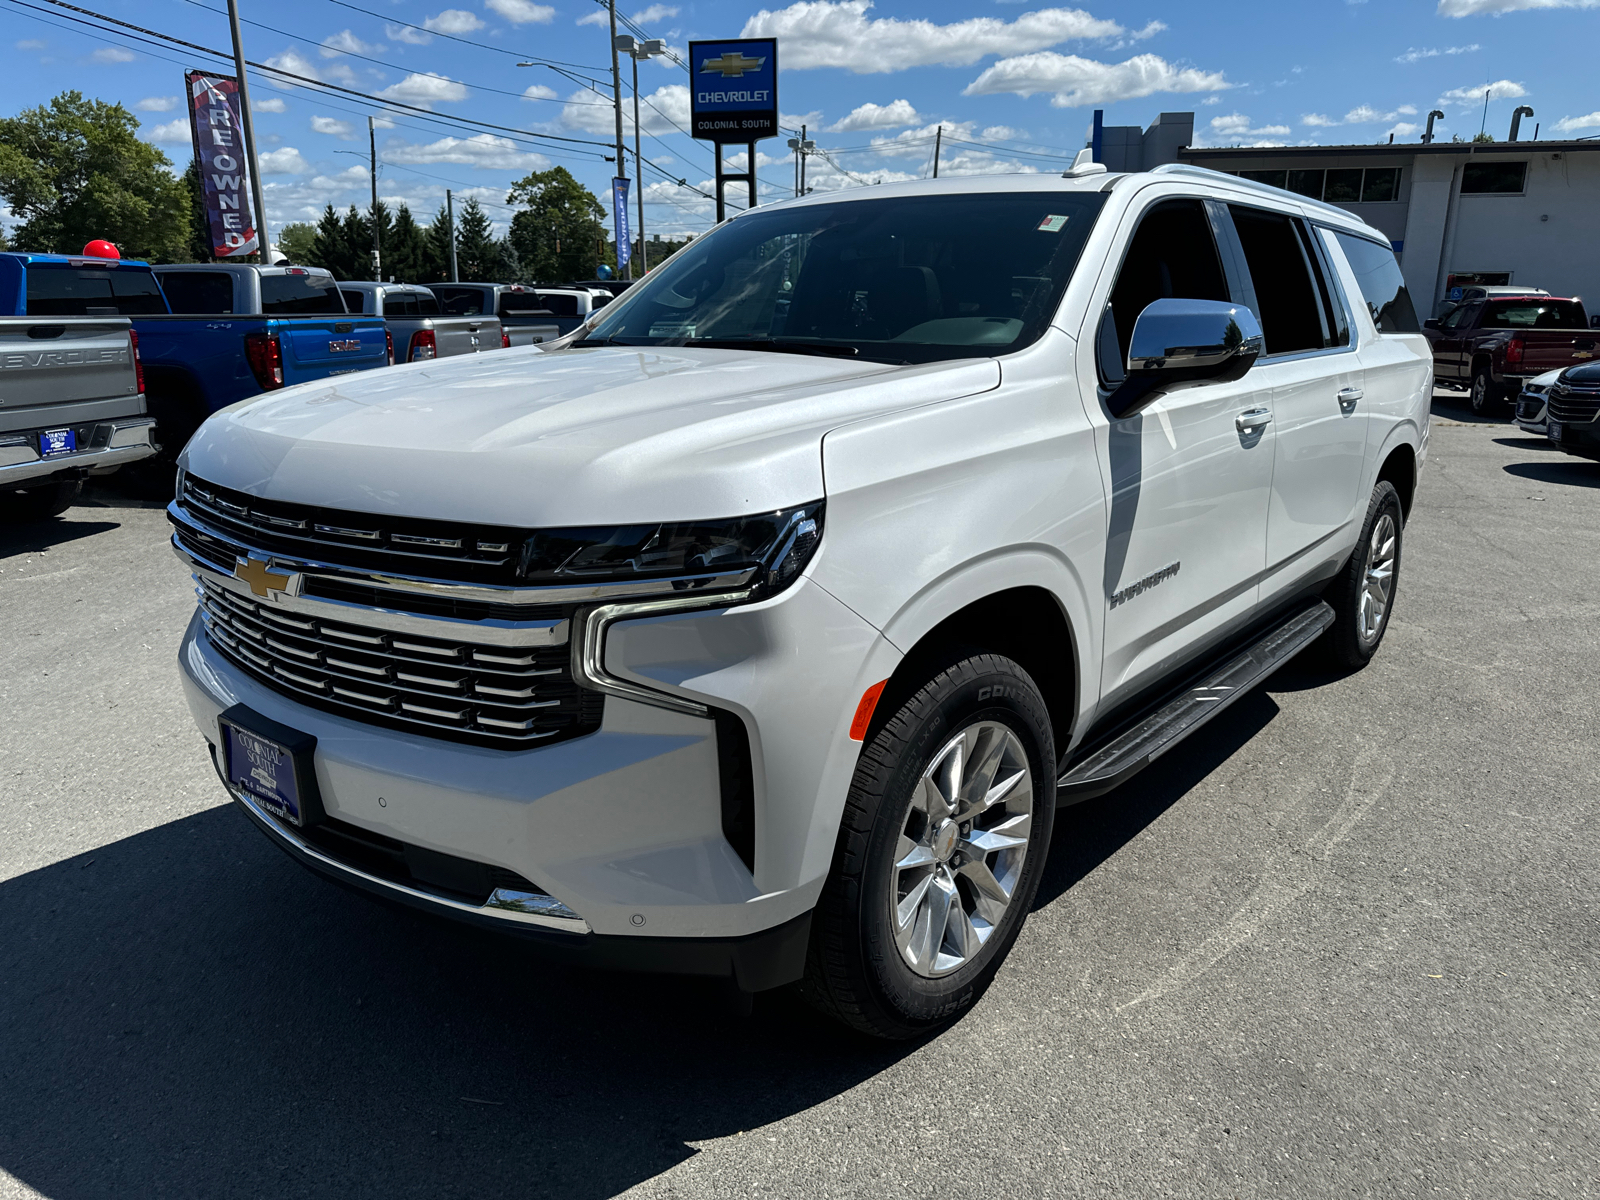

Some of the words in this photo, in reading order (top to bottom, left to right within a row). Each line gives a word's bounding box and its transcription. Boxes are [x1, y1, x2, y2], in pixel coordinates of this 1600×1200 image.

[698, 90, 769, 103] CHEVROLET
[207, 88, 233, 147] PRE
[698, 121, 739, 130] COLONIAL
[742, 120, 770, 129] SOUTH
[211, 154, 246, 248] OWNED
[619, 191, 629, 265] CHEVROLET
[329, 339, 361, 352] GMC
[1109, 561, 1181, 611] SUBURBAN
[239, 733, 282, 766] COLONIAL
[247, 750, 276, 776] SOUTH
[266, 803, 285, 817] SOUTH
